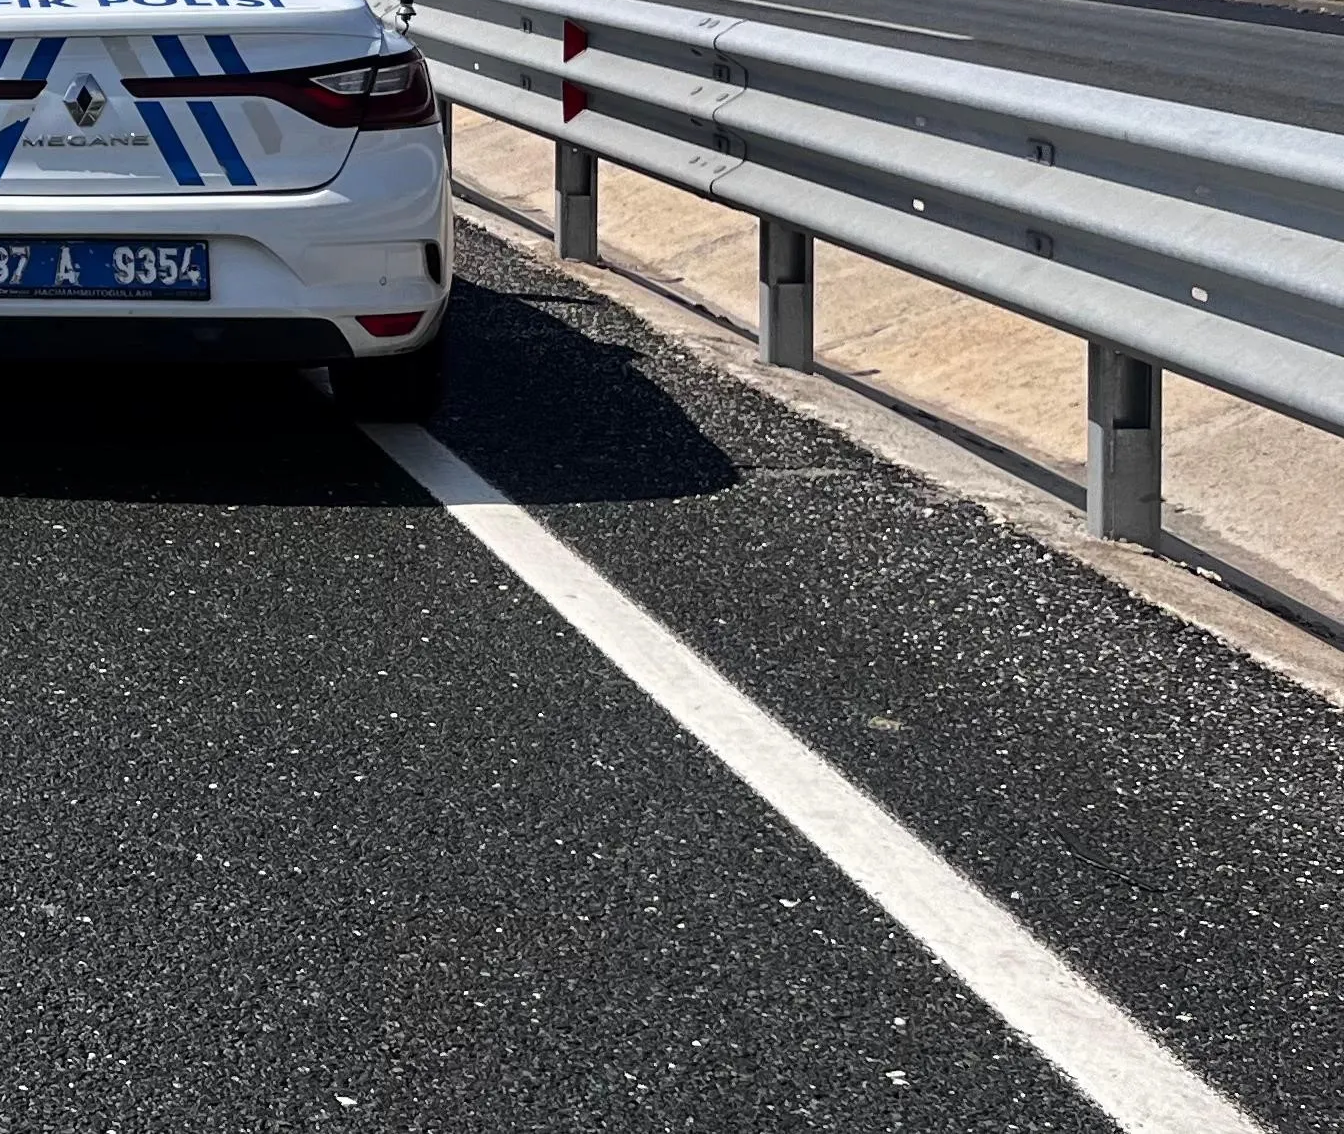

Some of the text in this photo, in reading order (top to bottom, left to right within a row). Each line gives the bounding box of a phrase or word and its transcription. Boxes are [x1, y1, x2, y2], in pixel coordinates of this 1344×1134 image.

[21, 133, 150, 147] MEGANE
[55, 246, 80, 285] A
[112, 246, 202, 286] 9354
